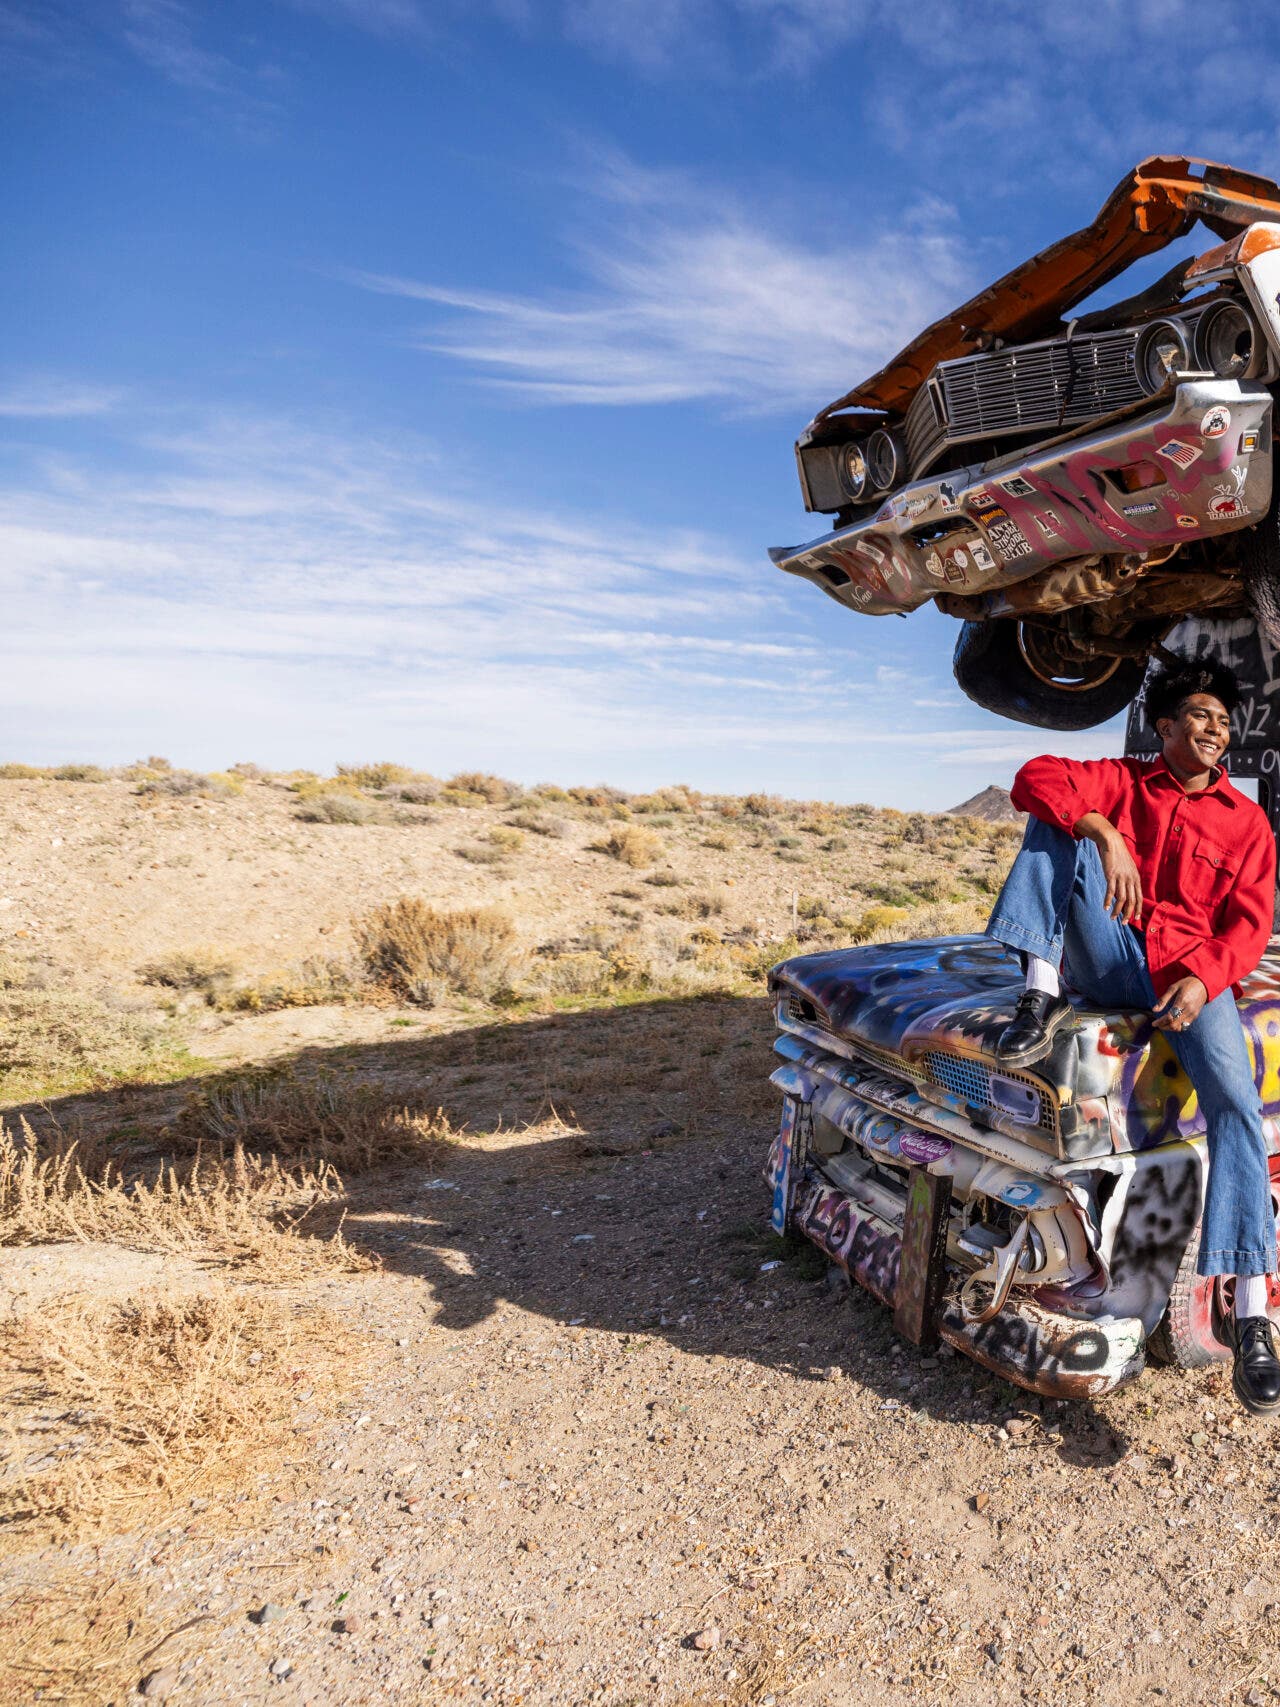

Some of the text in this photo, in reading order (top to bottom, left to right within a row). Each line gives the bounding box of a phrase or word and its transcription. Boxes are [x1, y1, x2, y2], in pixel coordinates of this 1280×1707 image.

[987, 520, 1016, 541] ANTI
[993, 525, 1020, 550] STROBE
[999, 532, 1025, 557] STROBE
[1004, 542, 1033, 561] CLUB
